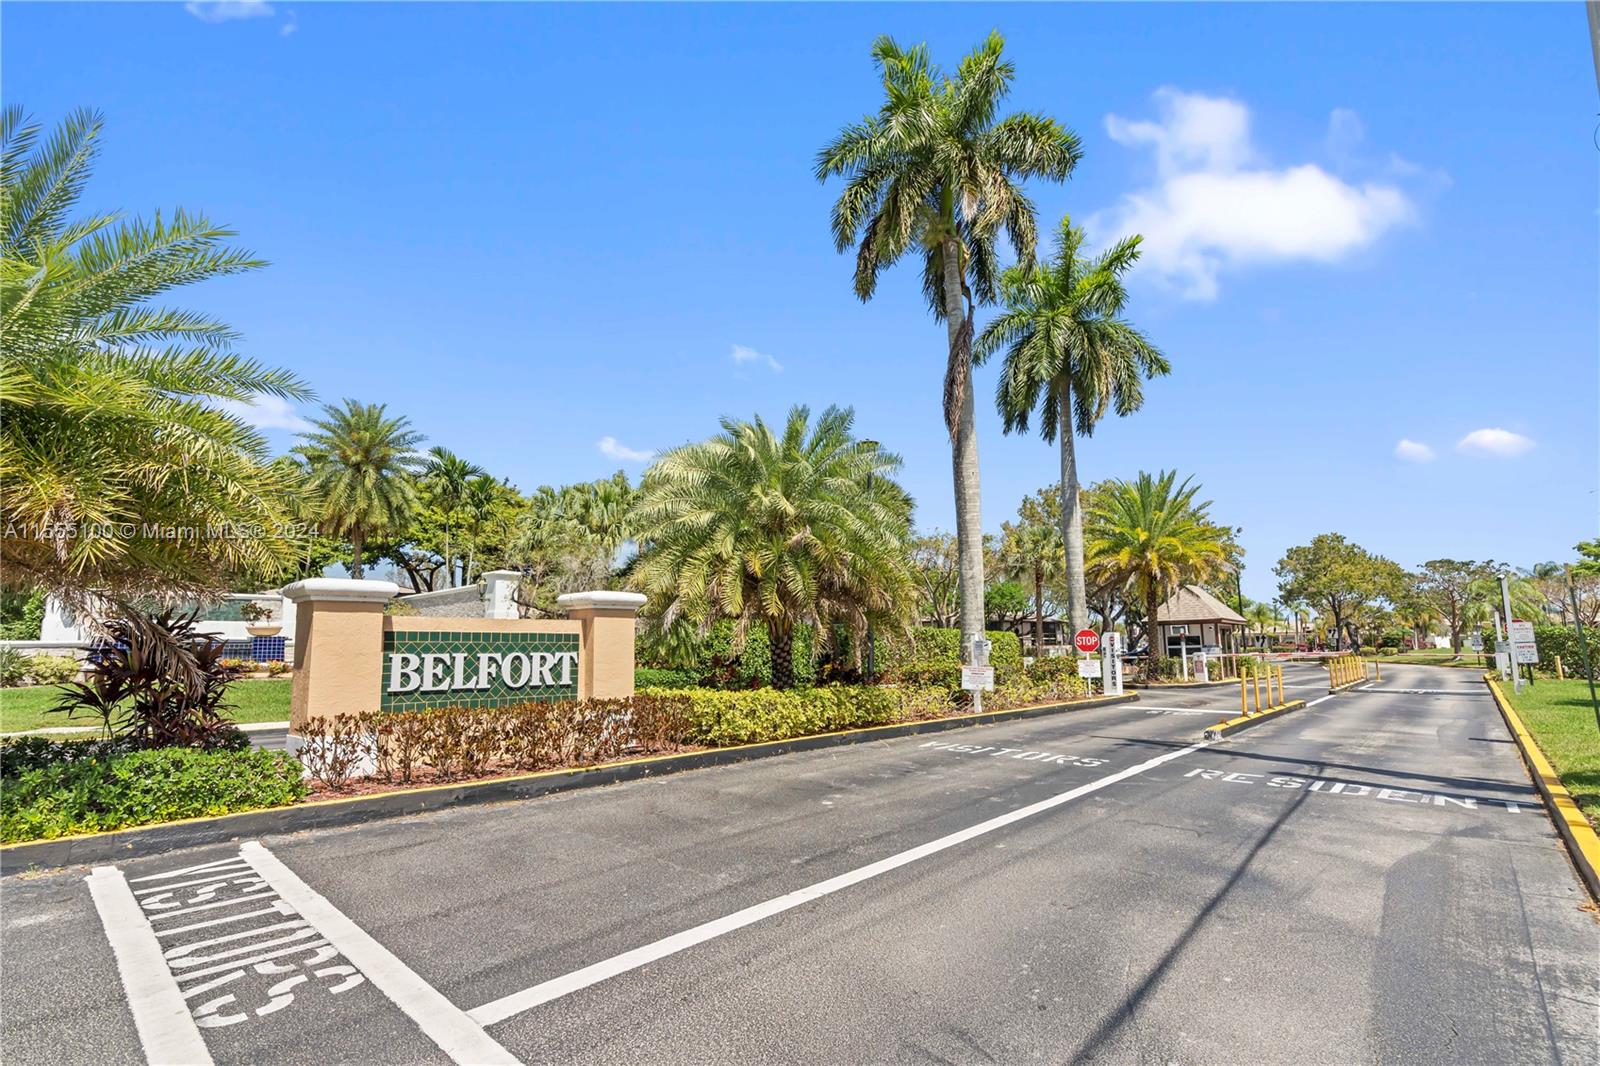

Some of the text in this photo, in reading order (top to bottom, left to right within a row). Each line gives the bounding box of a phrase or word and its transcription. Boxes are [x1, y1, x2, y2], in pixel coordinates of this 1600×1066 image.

[1076, 636, 1098, 646] STOP
[387, 652, 579, 692] BELFORT
[919, 740, 1110, 768] VISITORS
[130, 856, 366, 1028] VISITORS
